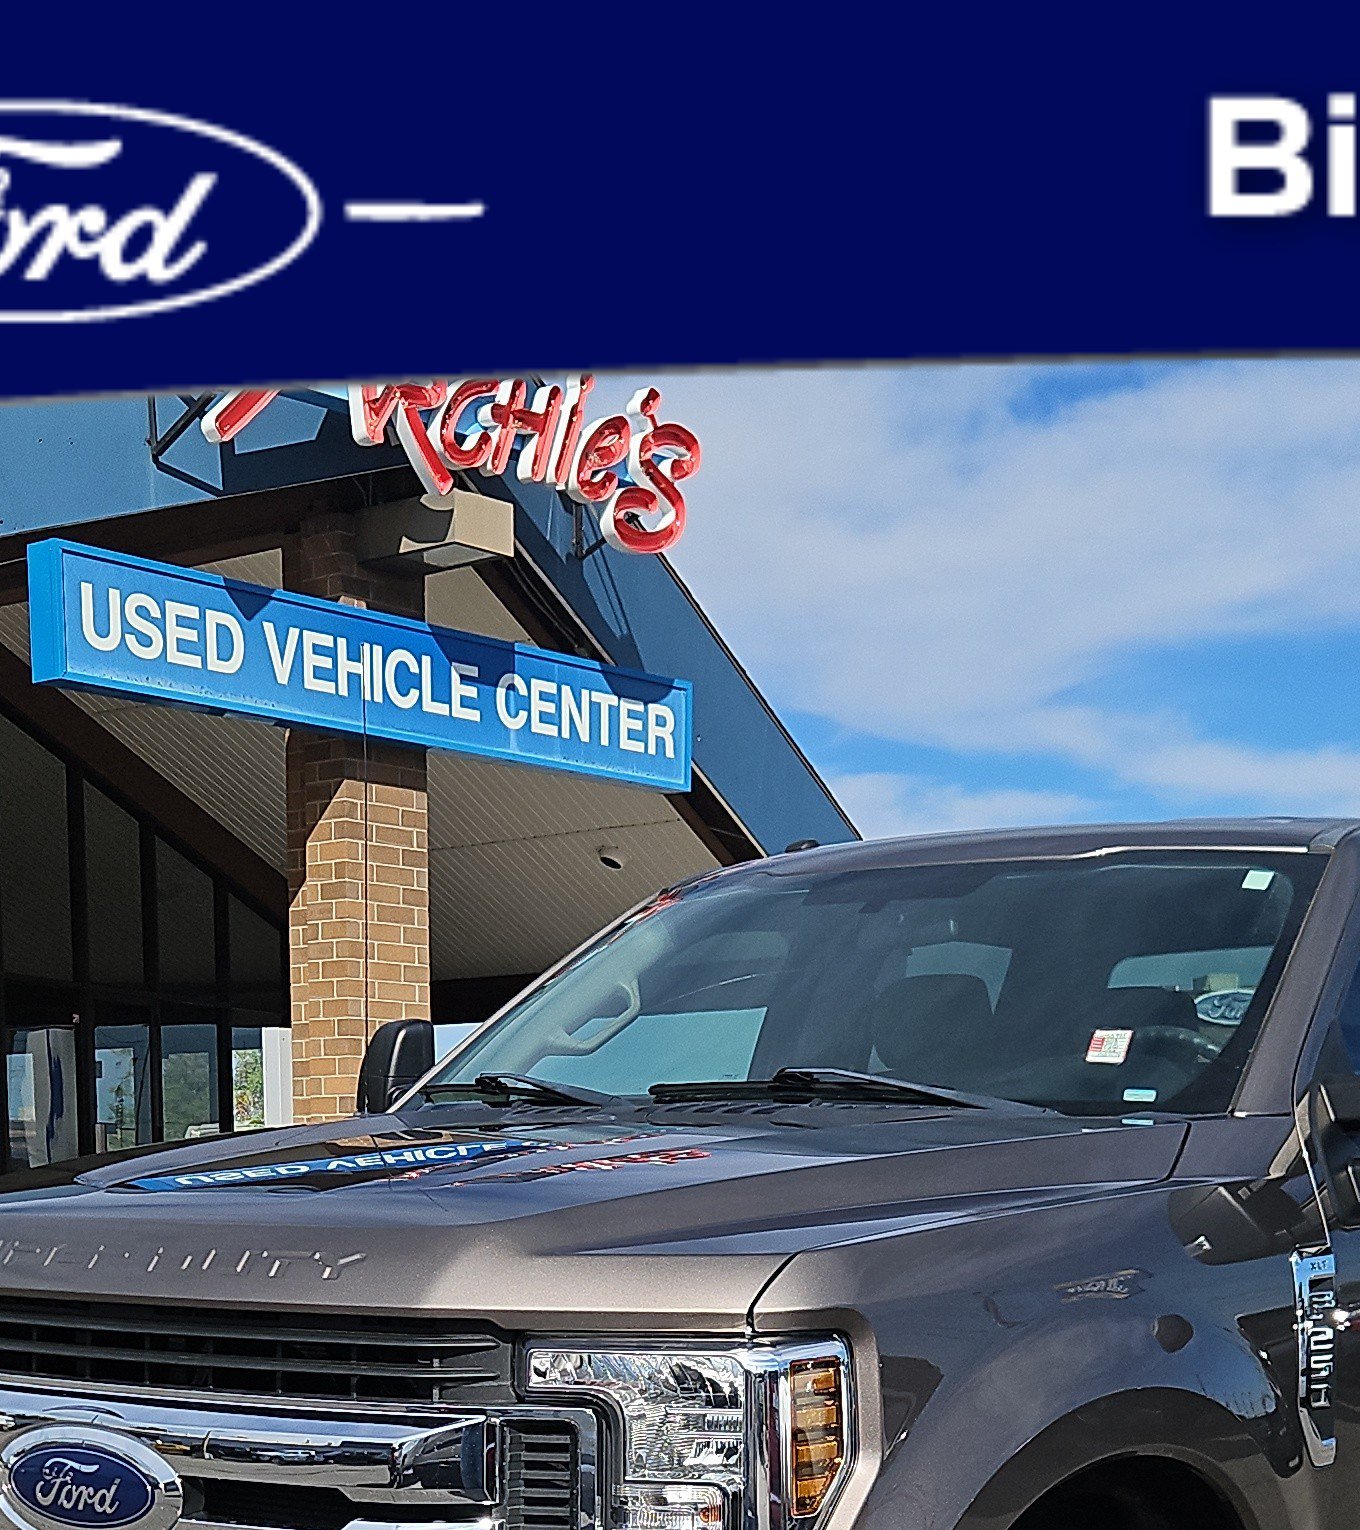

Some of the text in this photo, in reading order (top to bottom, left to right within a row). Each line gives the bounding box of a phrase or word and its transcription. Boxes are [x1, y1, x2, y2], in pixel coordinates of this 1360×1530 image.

[80, 582, 676, 759] USED VEHICLE CENTER
[36, 1457, 121, 1515] Ford
